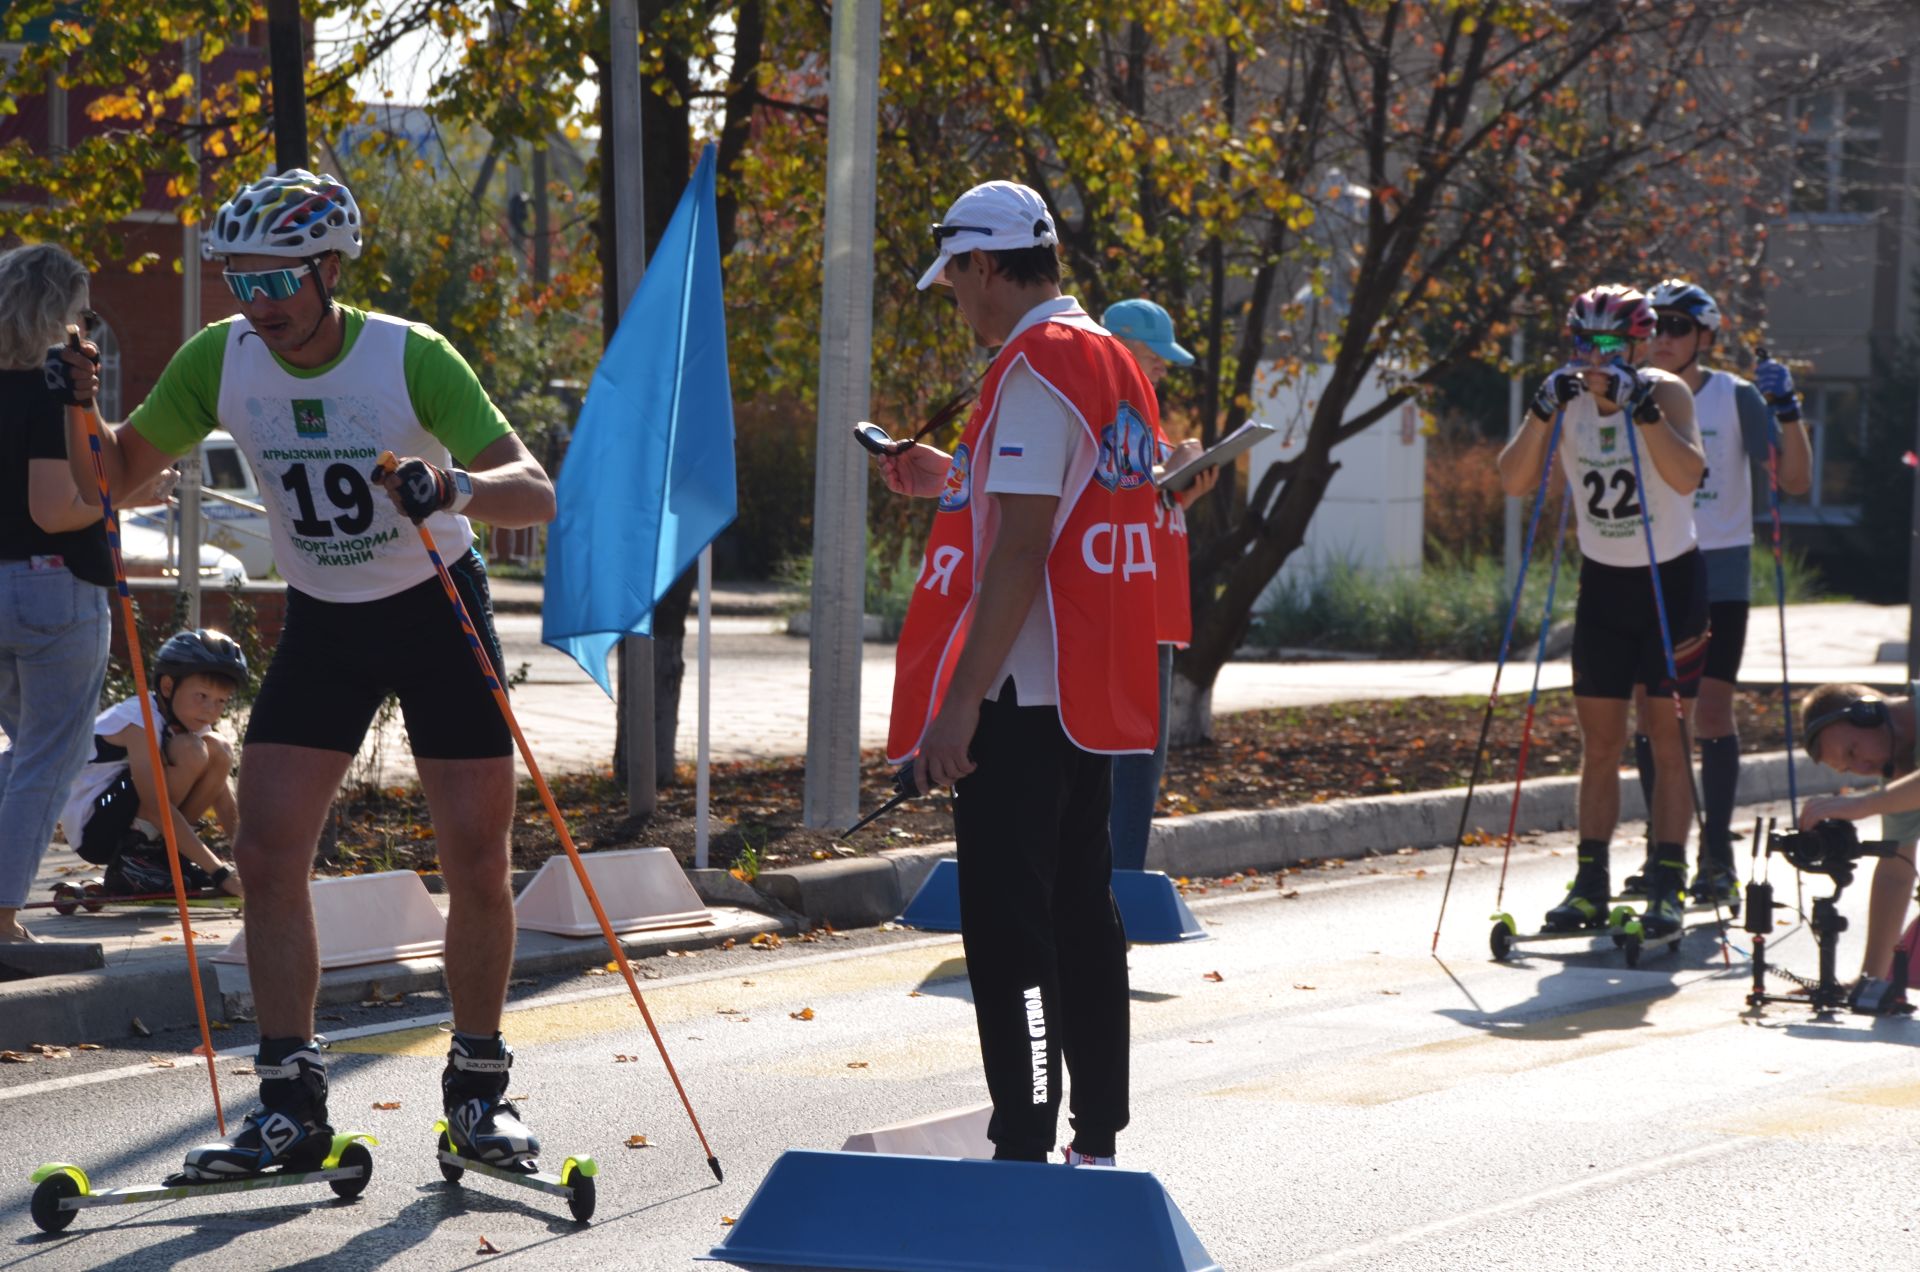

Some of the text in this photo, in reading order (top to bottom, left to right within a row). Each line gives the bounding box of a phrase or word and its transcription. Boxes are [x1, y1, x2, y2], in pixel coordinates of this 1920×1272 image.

[263, 446, 377, 460] АГРЫЗСКИЙ РАЙОН
[281, 463, 374, 538] 19
[1583, 468, 1642, 520] 22
[316, 551, 374, 566] ЖИЗНИ
[1023, 986, 1048, 1104] WORLD BALANCE
